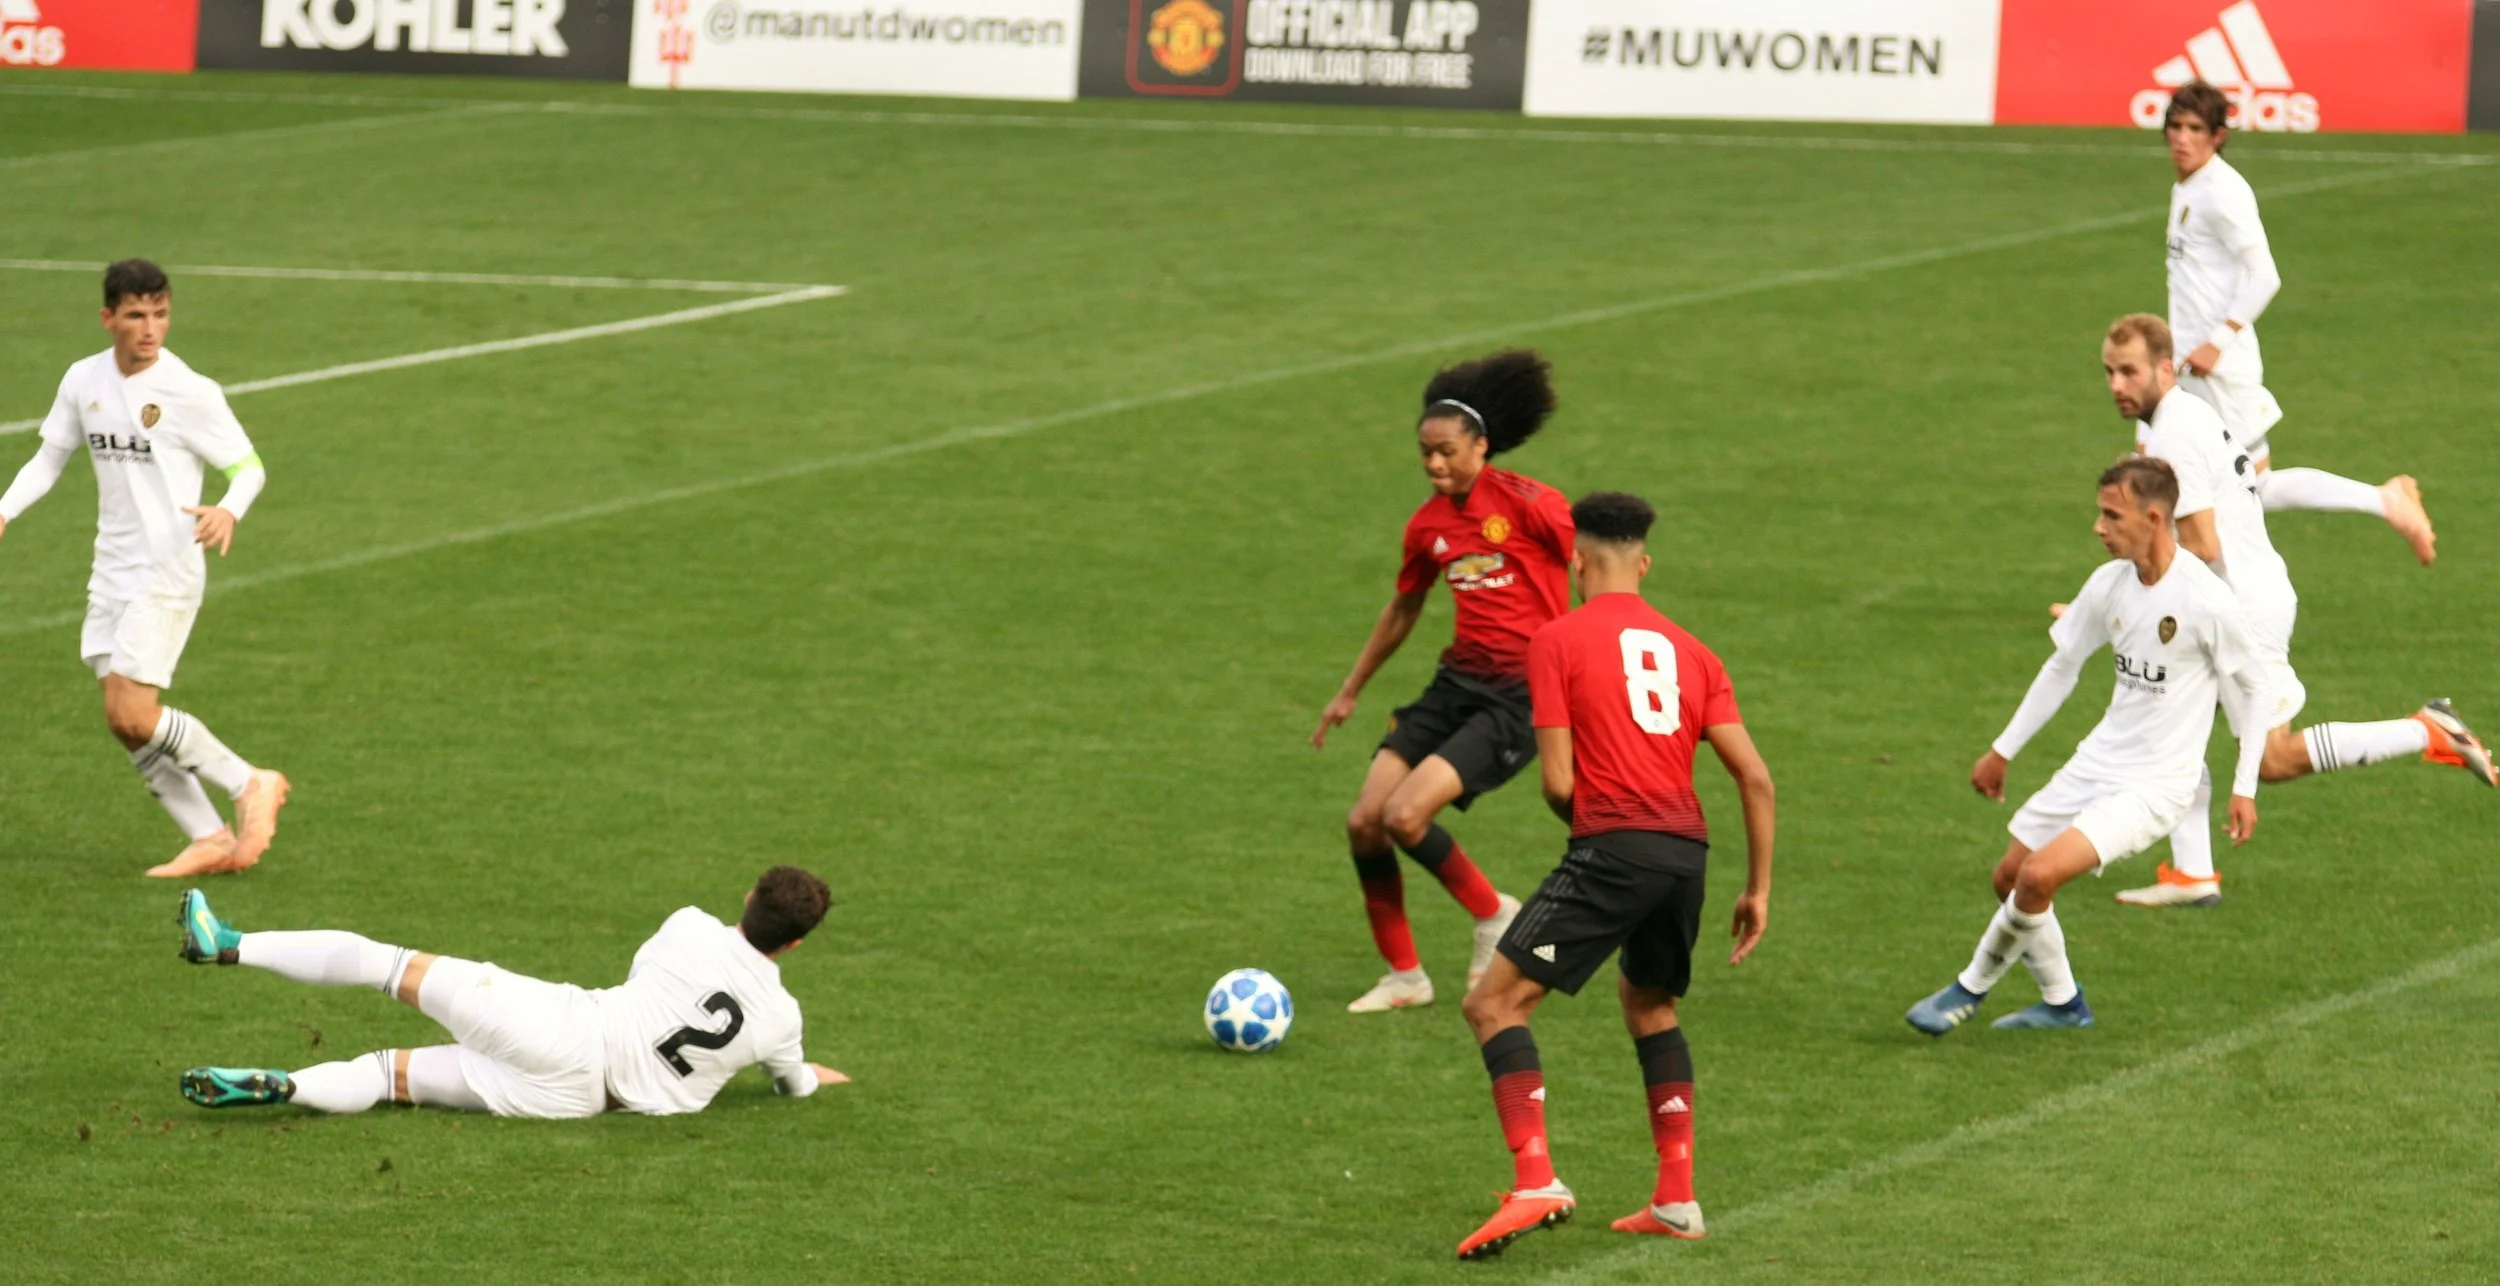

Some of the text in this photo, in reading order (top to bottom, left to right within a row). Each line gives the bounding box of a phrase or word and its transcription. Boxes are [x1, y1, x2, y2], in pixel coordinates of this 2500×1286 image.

[260, 0, 569, 57] KOHLER
[704, 1, 1068, 46] @manutdwomen
[1246, 0, 1480, 51] OFFICIAL APP
[1244, 47, 1474, 89] DOWNLOAD FOR FREE
[1580, 28, 1945, 76] #MUWOMEN
[2128, 82, 2321, 133] adas
[88, 433, 151, 453] BLU
[1618, 627, 1682, 736] 8
[2114, 653, 2167, 683] BLU
[652, 988, 745, 1081] 2
